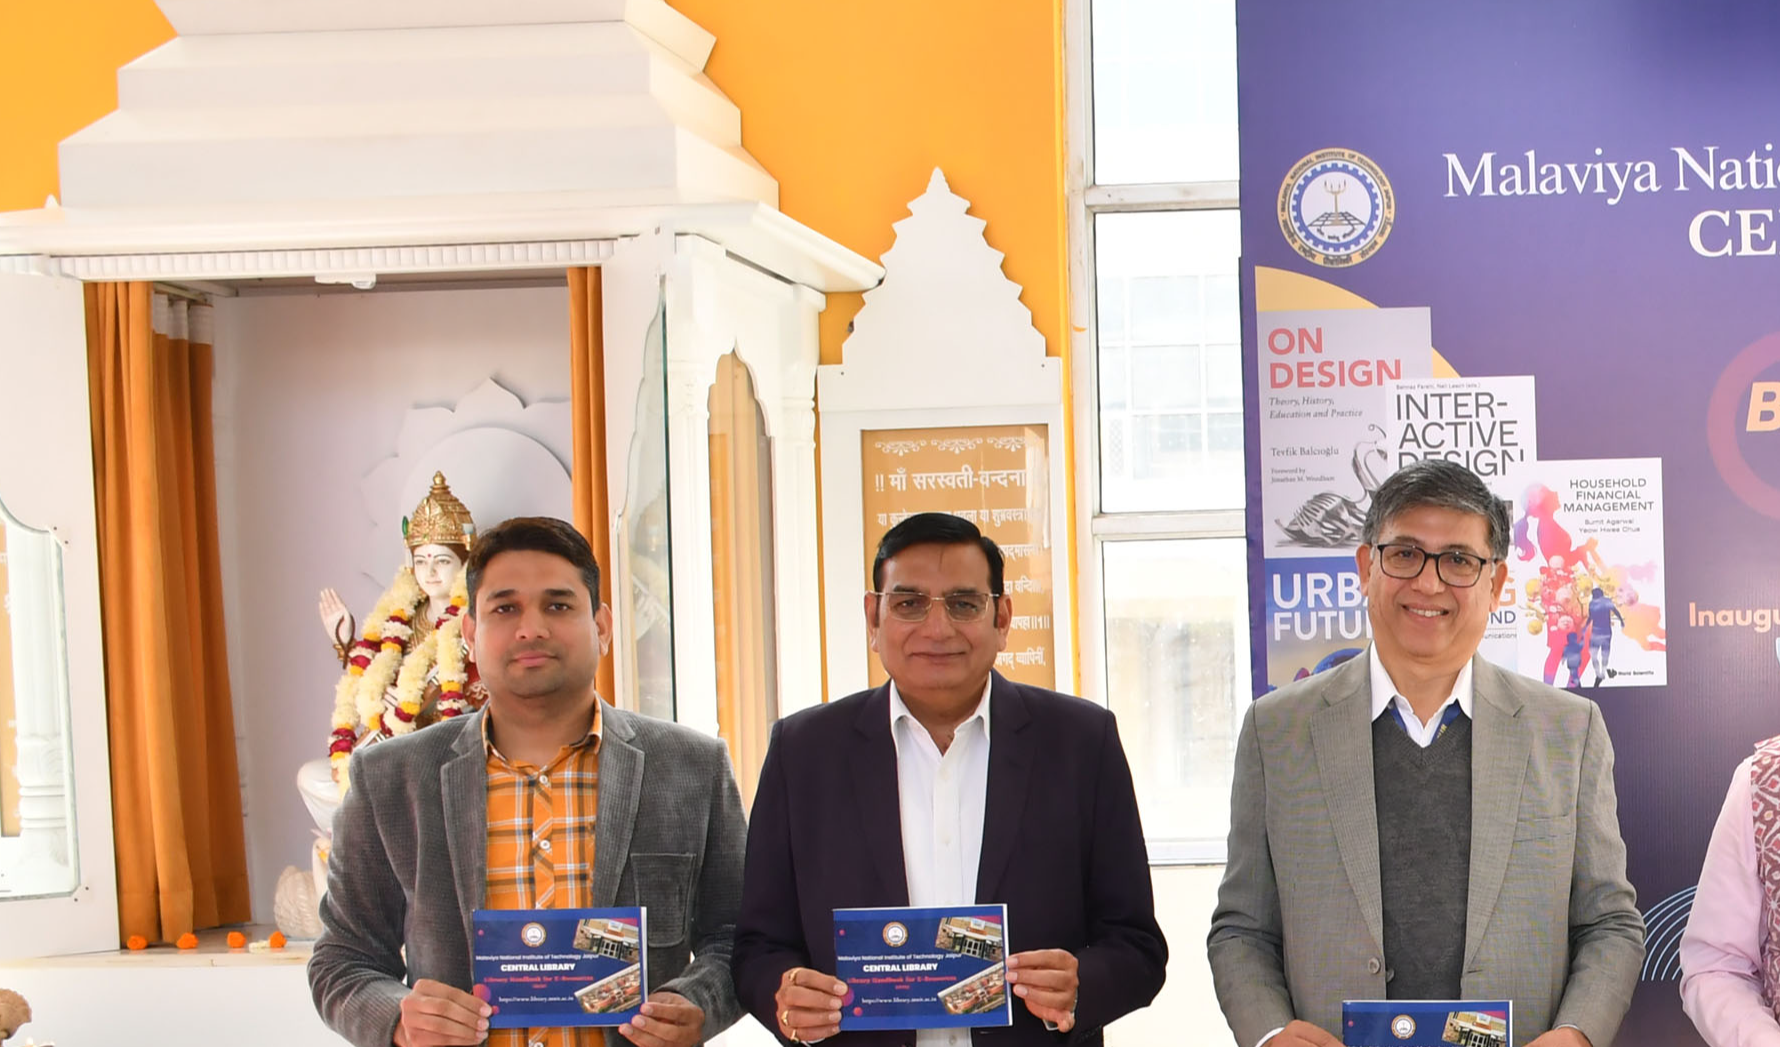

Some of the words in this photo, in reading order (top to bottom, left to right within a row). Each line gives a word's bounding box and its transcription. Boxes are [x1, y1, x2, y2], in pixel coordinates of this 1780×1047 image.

[1443, 149, 1660, 205] Malaviya
[1268, 327, 1323, 355] ON
[1269, 359, 1401, 389] DESIGN
[1269, 397, 1300, 407] Theory,
[1302, 396, 1335, 406] History,
[1397, 392, 1507, 420] INTER-
[1269, 410, 1311, 419] Education
[1313, 409, 1328, 418] and
[1331, 408, 1363, 418] Practice
[1399, 420, 1518, 449] ACTIVE
[1271, 447, 1297, 457] Tevfik
[1570, 478, 1647, 489] HOUSEHOLD
[1576, 490, 1641, 500] FINANCIAL
[1564, 501, 1654, 512] MANAGEMENT
[1273, 572, 1368, 609] URB
[501, 964, 538, 972] CENTRAL
[863, 964, 901, 972] CENTRAL
[902, 963, 938, 971] LIBRARY
